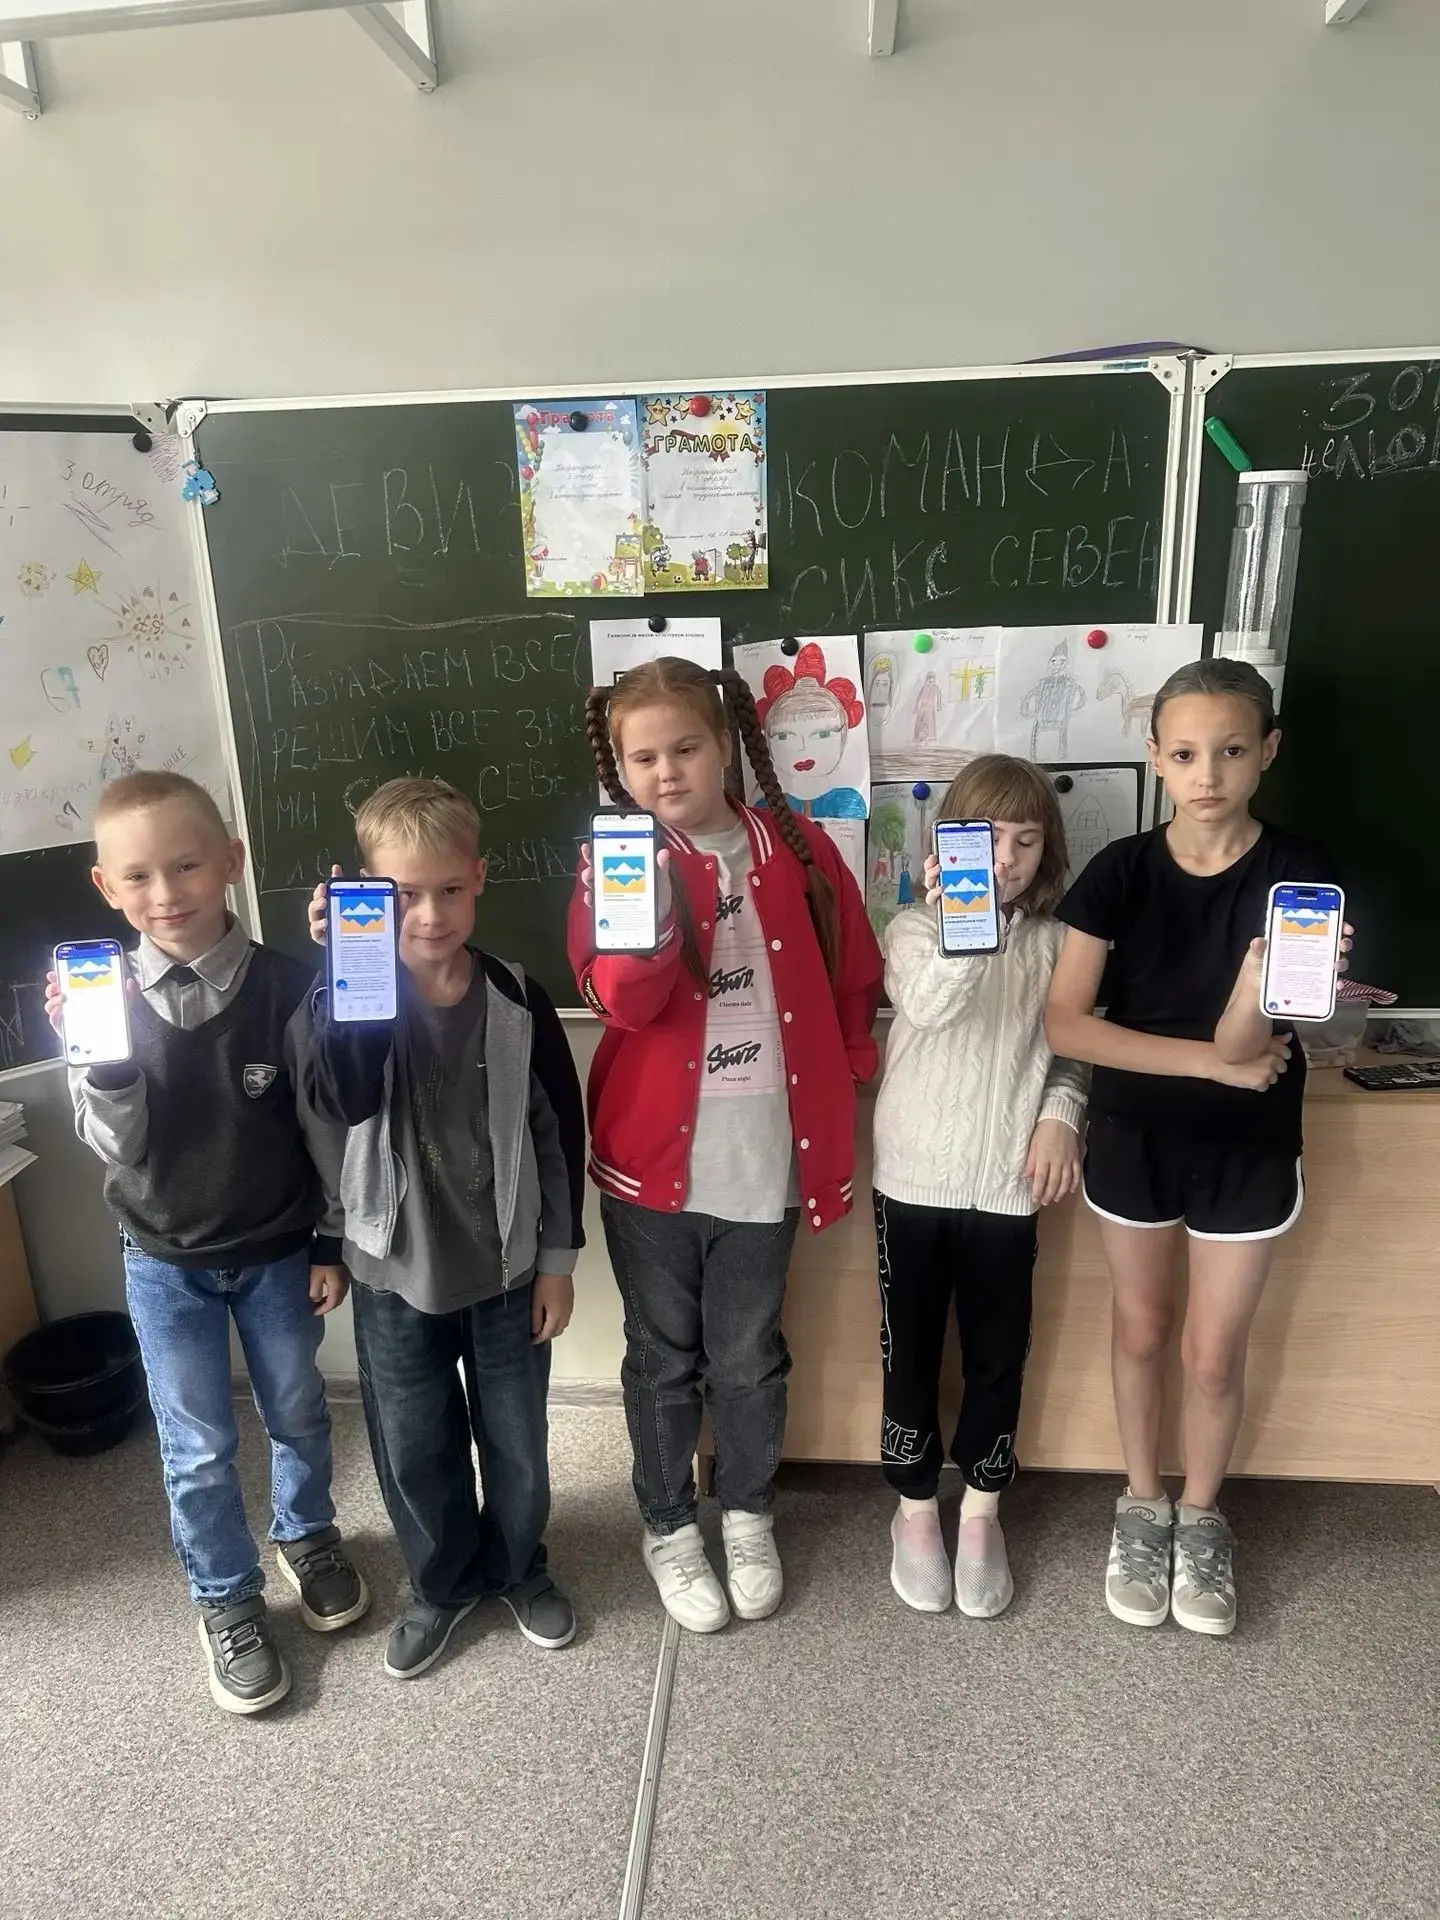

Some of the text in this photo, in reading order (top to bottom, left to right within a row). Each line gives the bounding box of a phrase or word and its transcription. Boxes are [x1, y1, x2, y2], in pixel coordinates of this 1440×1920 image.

[540, 409, 615, 425] Граота
[654, 433, 753, 453] ГРАМОТА
[62, 460, 76, 481] 3
